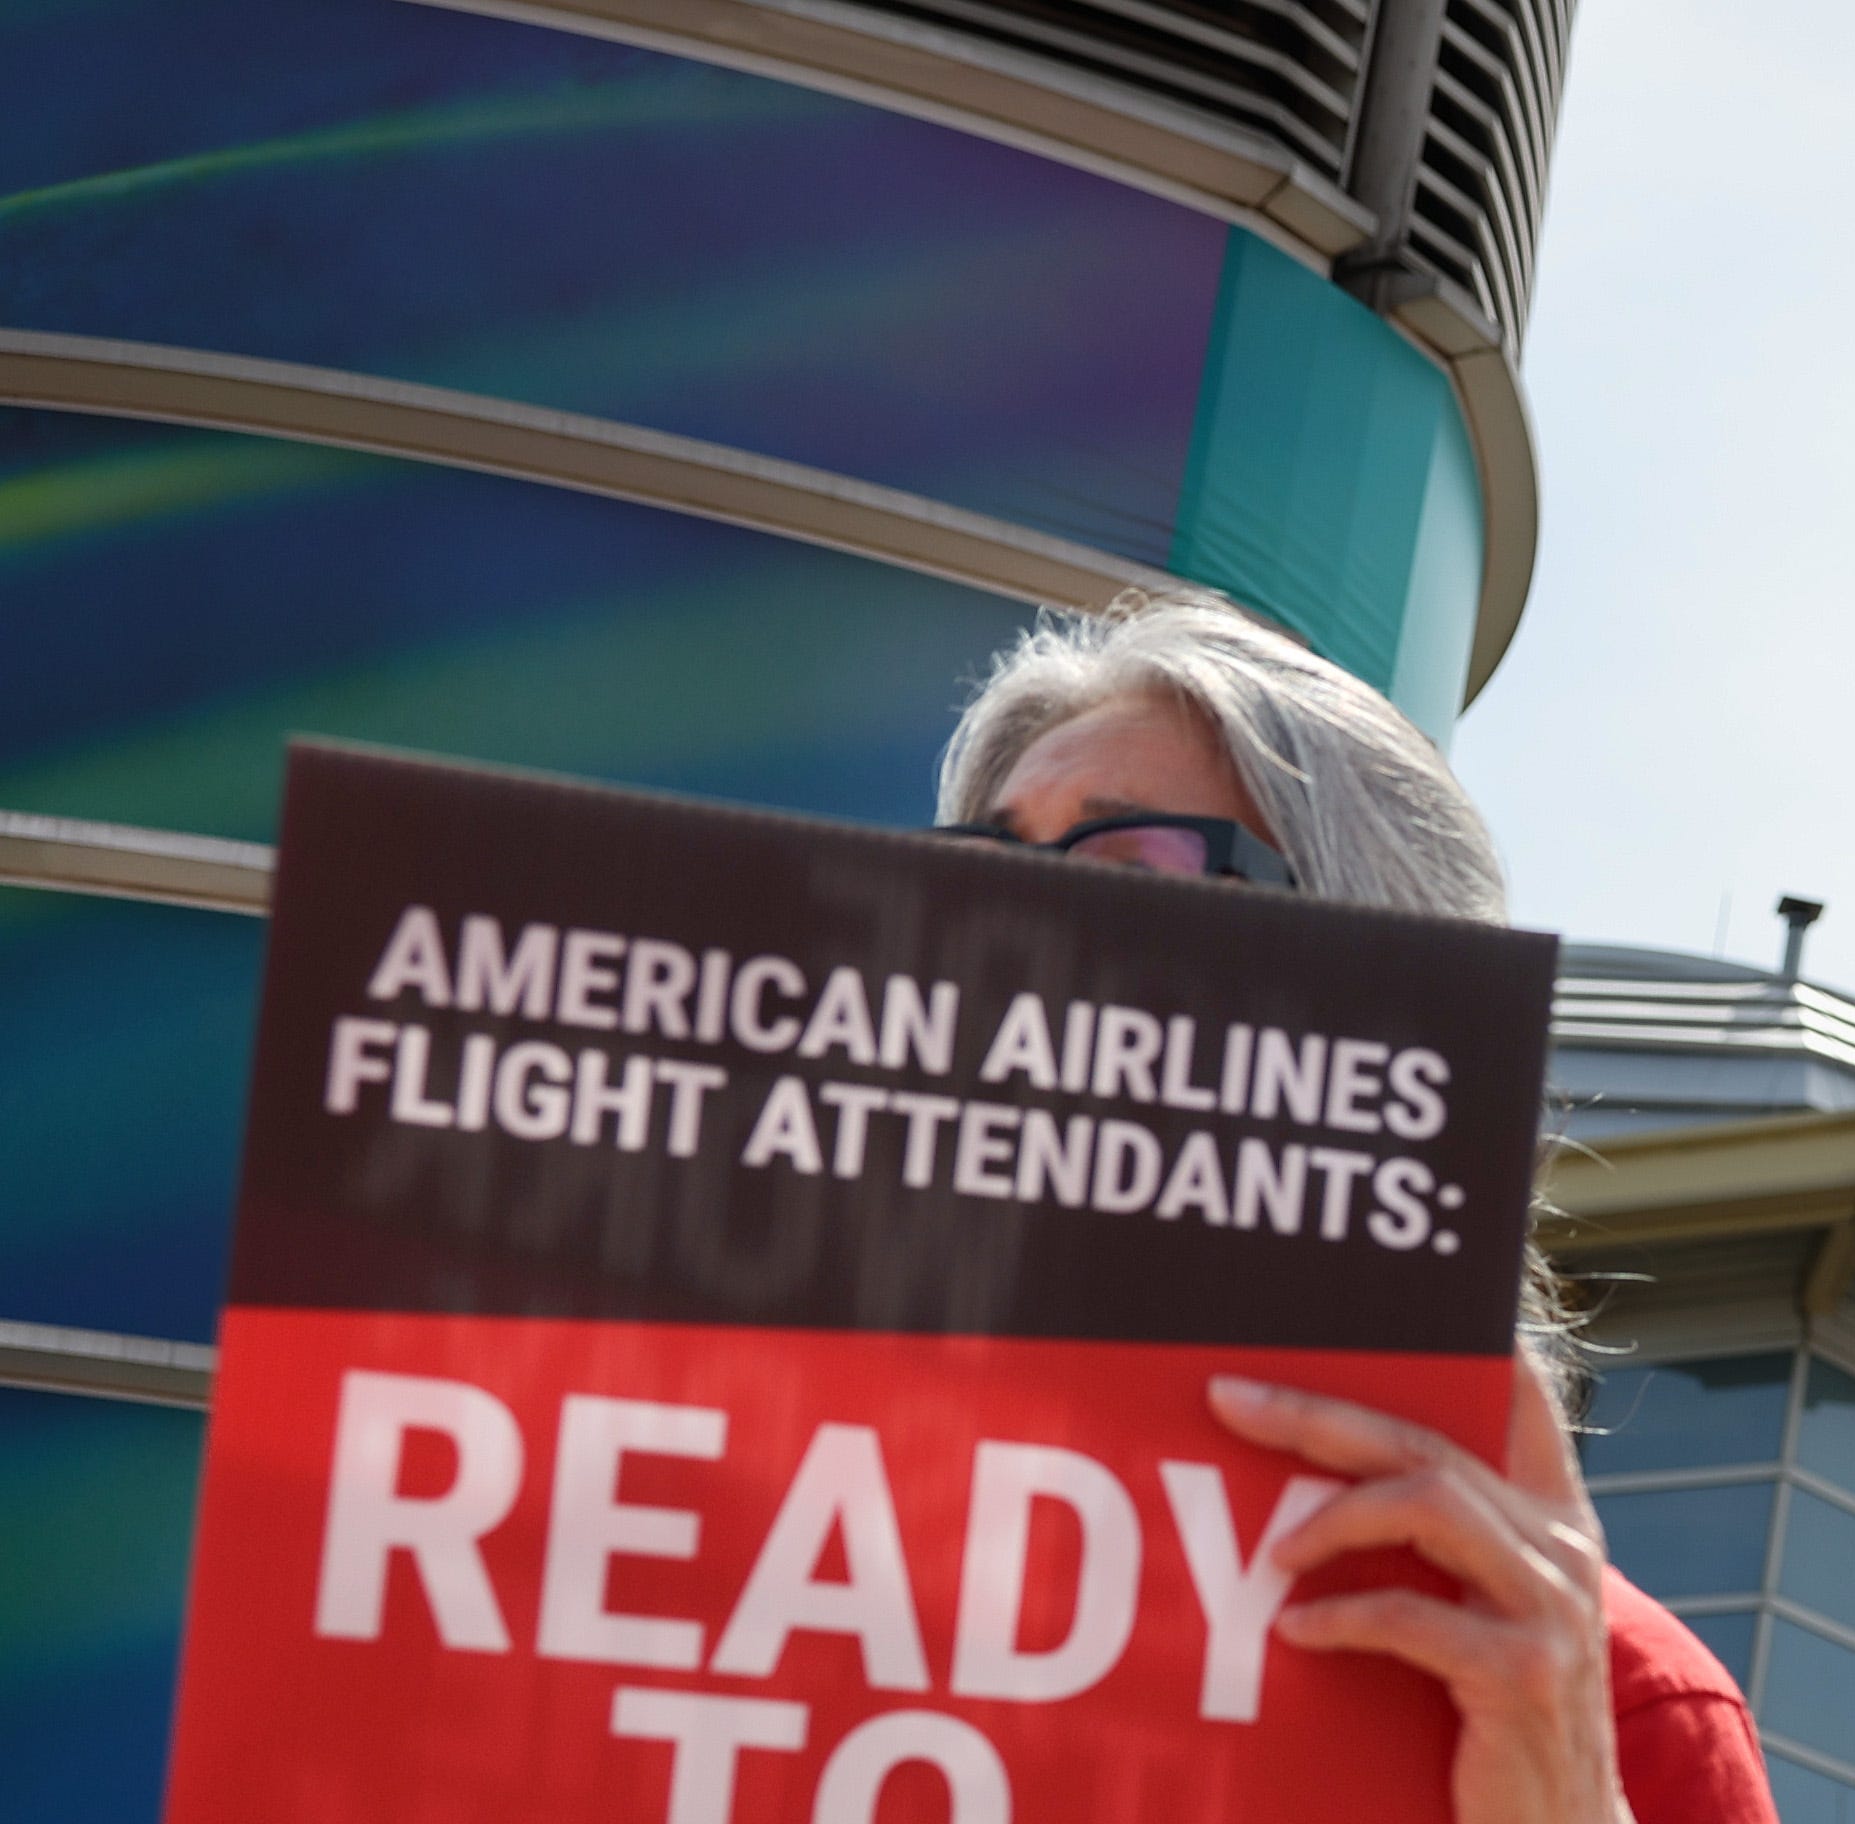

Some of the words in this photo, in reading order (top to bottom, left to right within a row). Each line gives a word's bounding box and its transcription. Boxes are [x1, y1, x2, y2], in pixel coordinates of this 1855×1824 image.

[326, 1016, 726, 1158] FLIGHT
[743, 1078, 1466, 1256] ATTENDANTS:
[370, 906, 960, 1076] AMERICAN
[983, 993, 1451, 1142] AIRLINES
[314, 1368, 1347, 1722] READY
